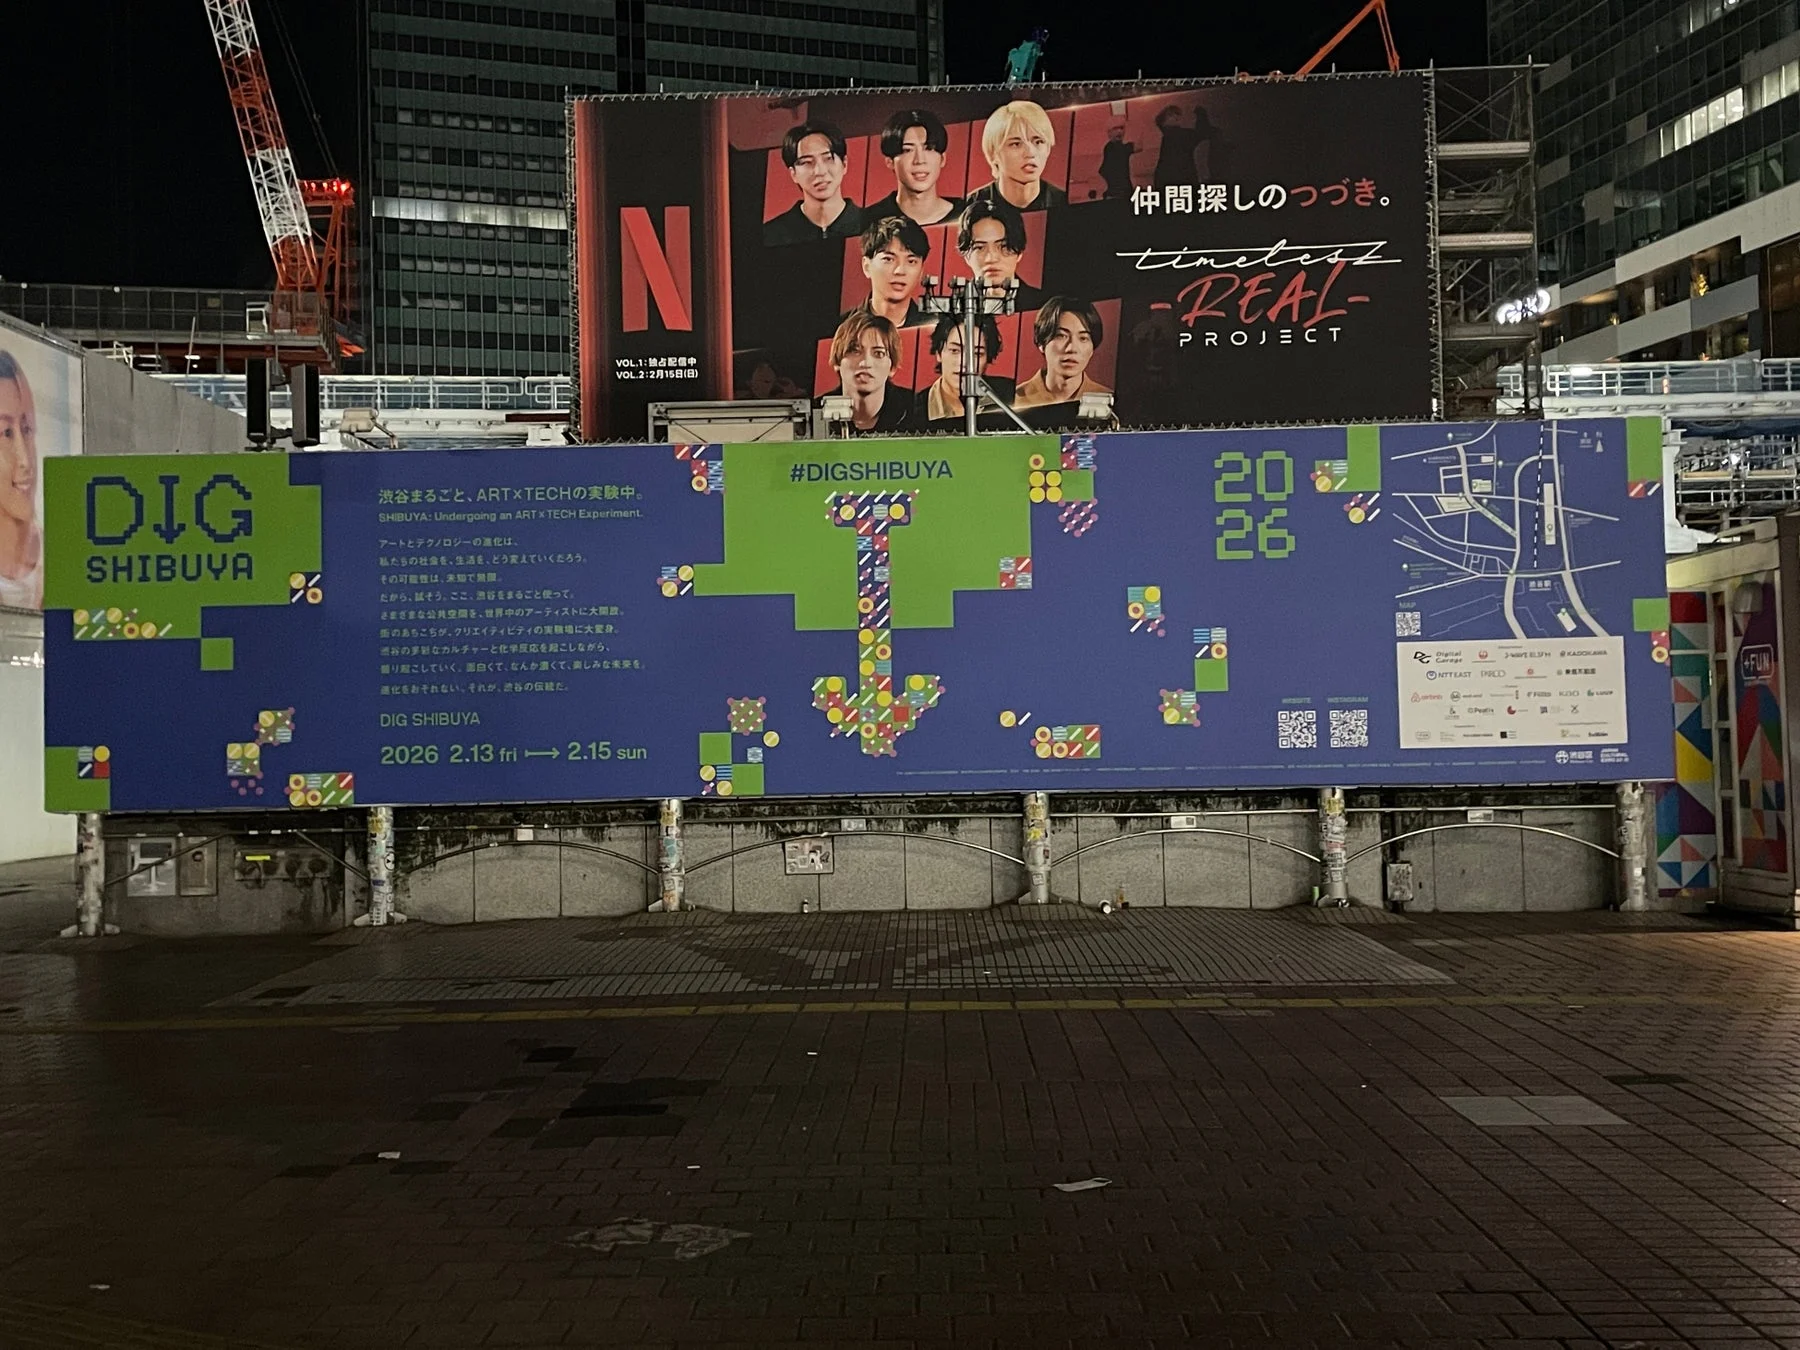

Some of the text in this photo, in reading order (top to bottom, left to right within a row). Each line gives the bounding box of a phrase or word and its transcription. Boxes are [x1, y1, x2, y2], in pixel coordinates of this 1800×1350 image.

[1130, 177, 1390, 215] 仲間探しのつづき。
[620, 206, 693, 332] N
[1179, 327, 1341, 347] PROJECT
[790, 460, 953, 483] #DIGSHIBUYA
[1214, 450, 1294, 503] 20
[379, 512, 432, 522] SHIBUYA:
[434, 511, 497, 523] Undergoing
[499, 512, 513, 520] an
[578, 508, 644, 519] Experiment.
[1215, 508, 1296, 559] 26
[86, 553, 253, 584] SHIBUYA
[380, 712, 480, 727] DIG SHIBUYA
[380, 741, 647, 765] 2026 2.13 fri 2.15 sun
